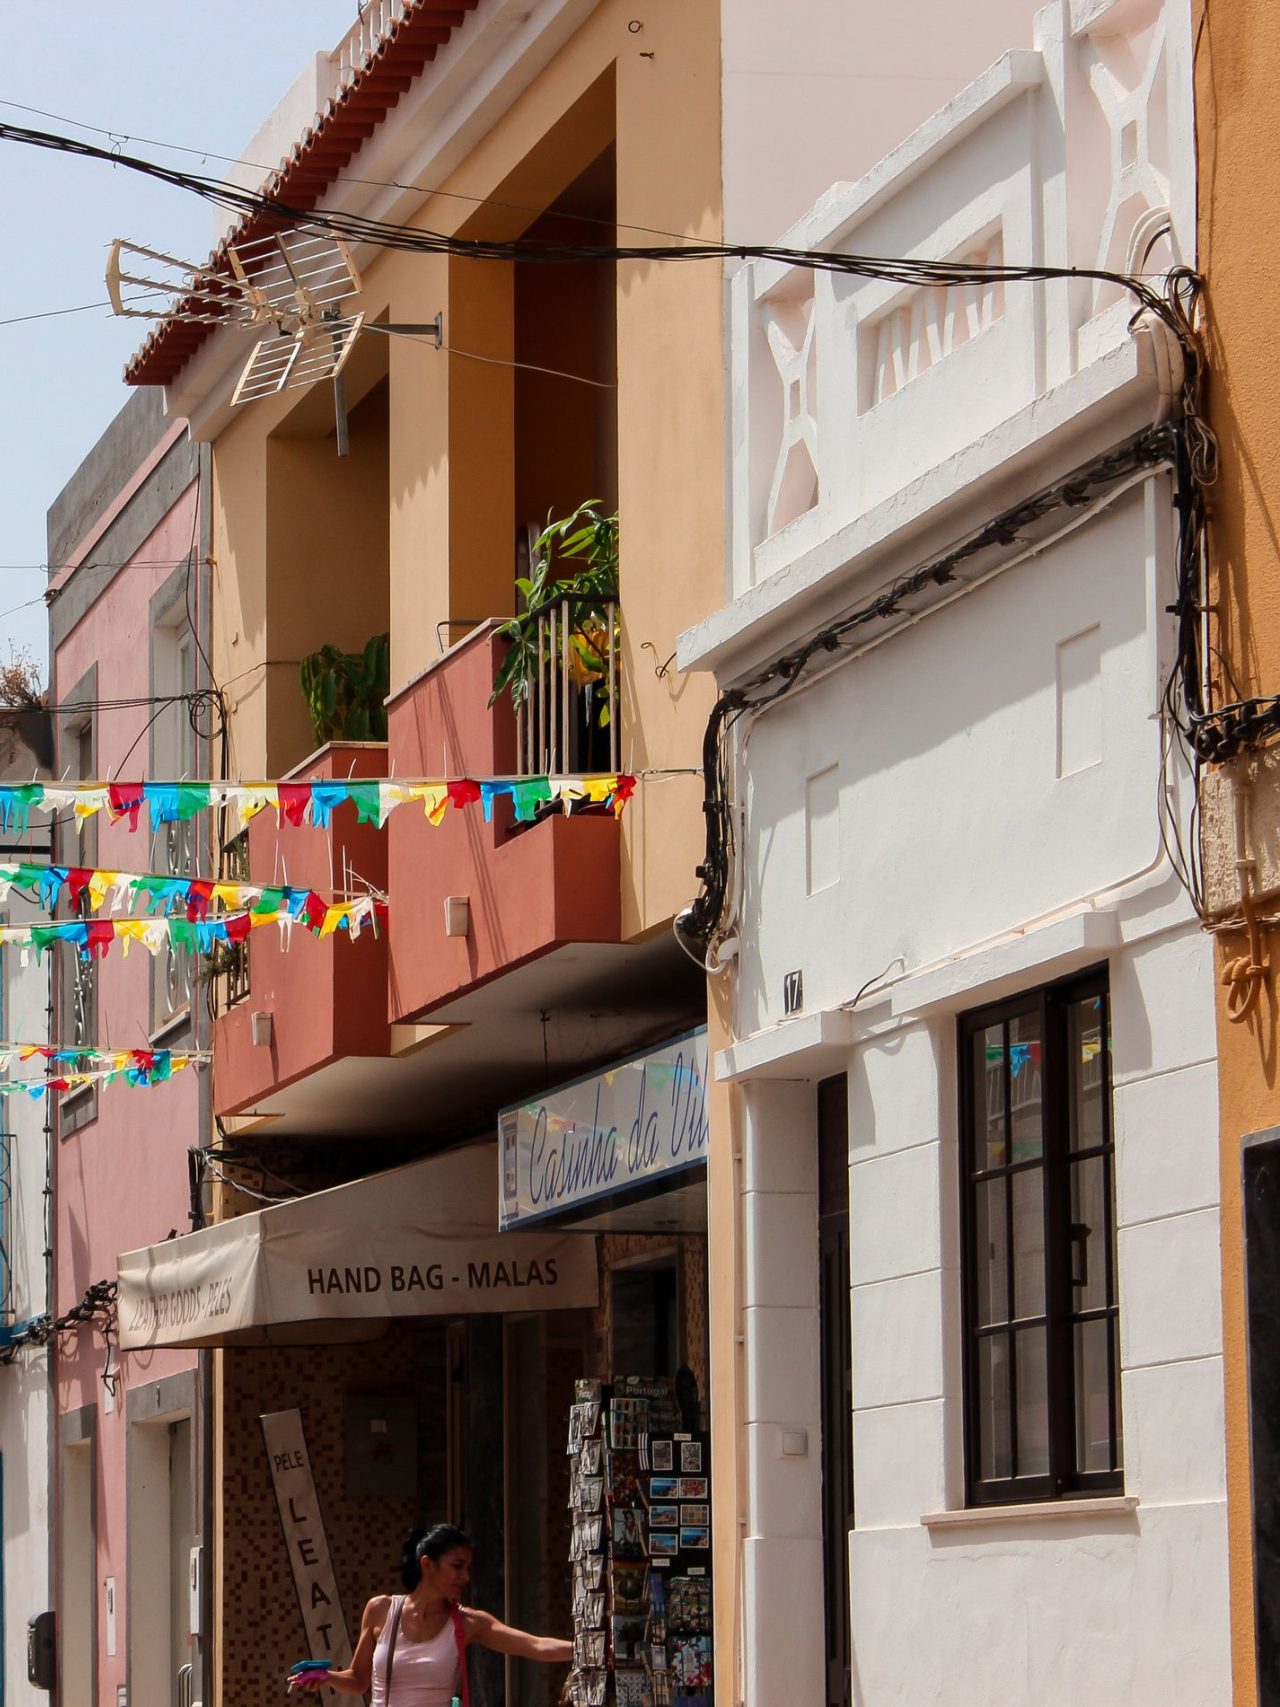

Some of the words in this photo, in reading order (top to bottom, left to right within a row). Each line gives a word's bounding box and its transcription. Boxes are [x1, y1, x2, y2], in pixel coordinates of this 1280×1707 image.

[786, 972, 800, 1013] 17
[530, 1081, 618, 1204] Casinha
[628, 1063, 660, 1174] da
[307, 1267, 381, 1294] HAND
[391, 1264, 444, 1292] BAG
[468, 1258, 558, 1288] MALAS
[128, 1295, 169, 1331] LEATHER
[170, 1286, 201, 1327] GOODS
[205, 1276, 232, 1318] PELES
[273, 1450, 304, 1472] PELE
